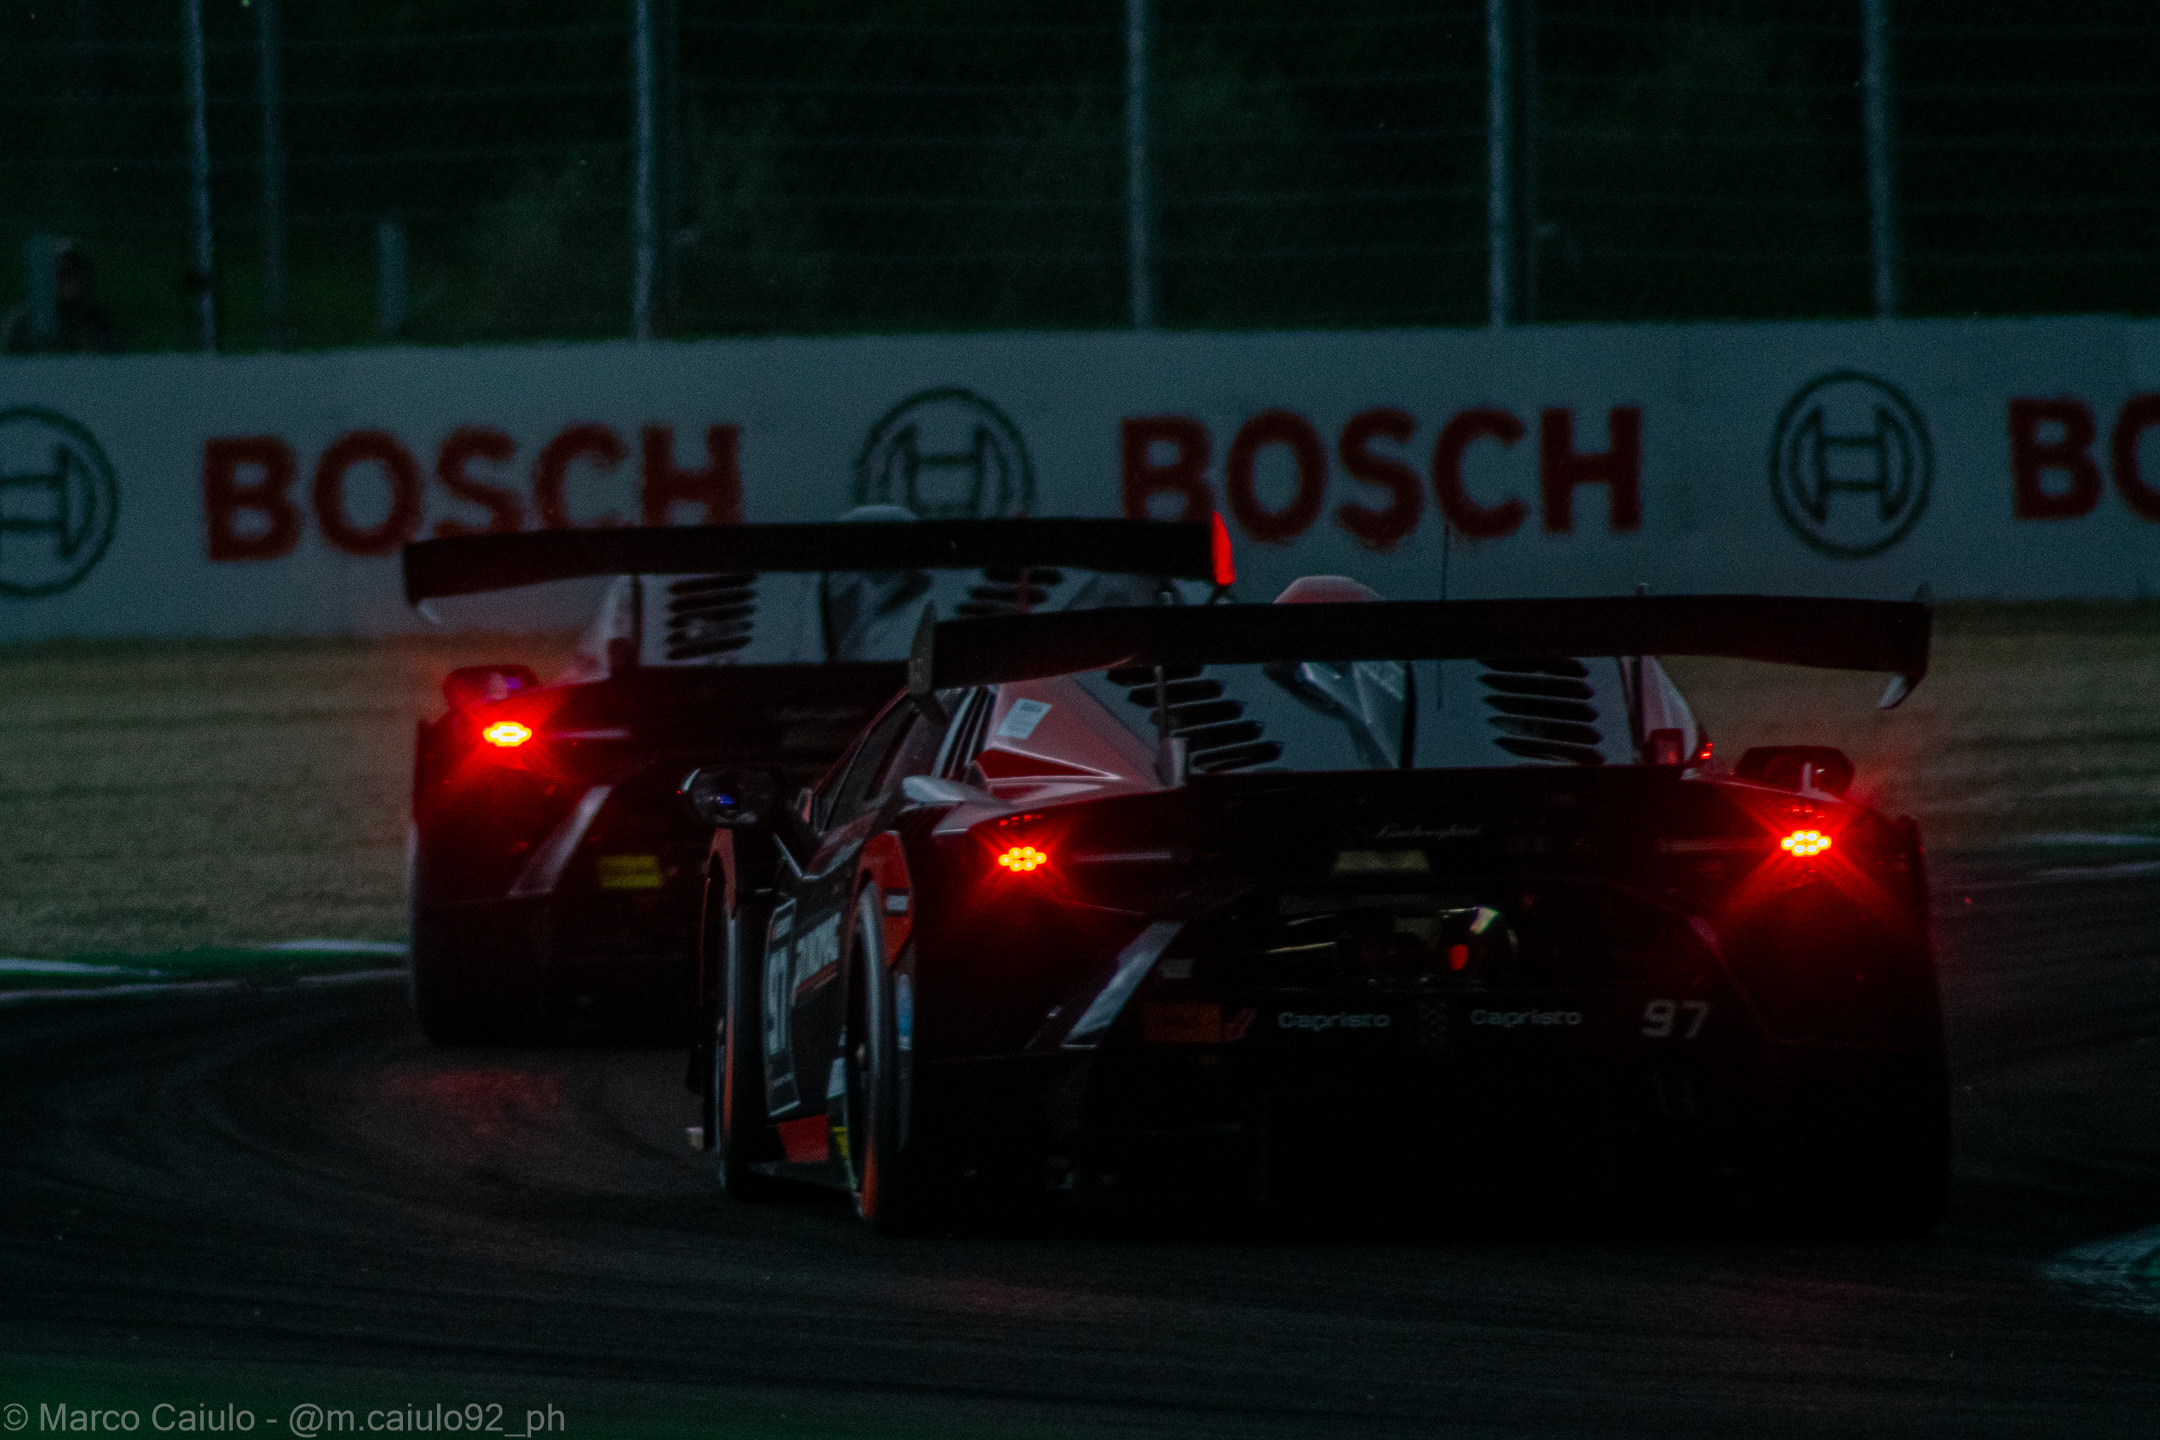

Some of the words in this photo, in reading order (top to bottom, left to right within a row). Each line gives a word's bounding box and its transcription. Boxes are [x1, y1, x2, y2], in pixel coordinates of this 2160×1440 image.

[204, 423, 744, 561] BOSCH
[1120, 406, 1644, 548] BOSCH
[1276, 1010, 1393, 1032] Capristo
[1469, 1008, 1584, 1030] Capristo
[1641, 998, 1712, 1039] 97
